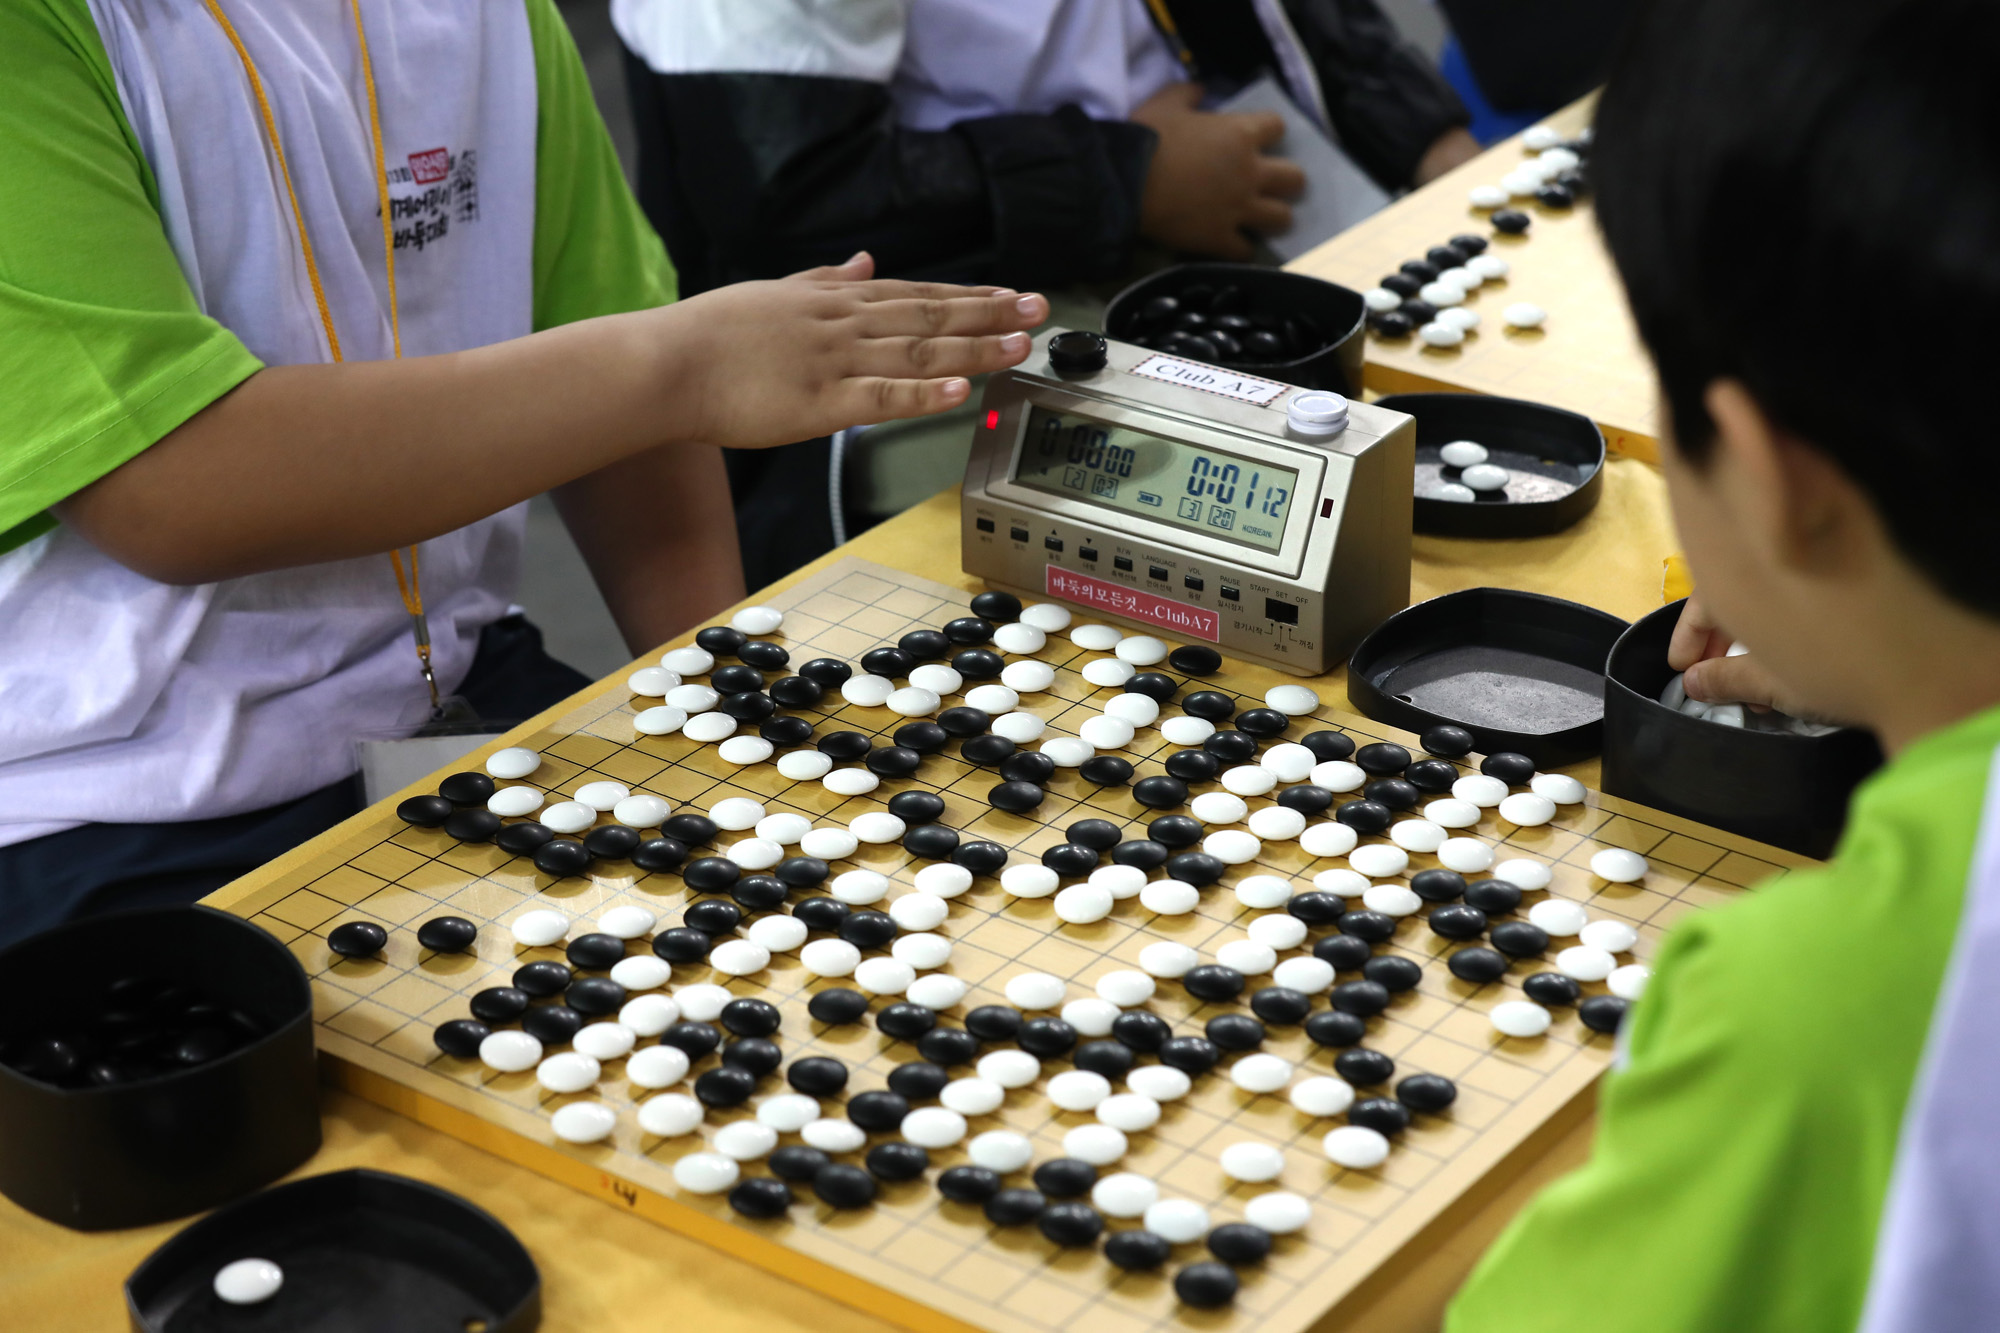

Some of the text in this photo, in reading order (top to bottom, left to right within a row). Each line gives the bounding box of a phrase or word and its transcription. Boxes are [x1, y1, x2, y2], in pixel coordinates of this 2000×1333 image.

[1156, 364, 1265, 395] Club A7
[1213, 508, 1232, 527] 20
[1141, 553, 1177, 569] LANGUAGE
[1188, 566, 1202, 576] VOL
[1220, 575, 1241, 586] PAUSE
[1250, 583, 1309, 605] START SET OFF
[1217, 600, 1244, 613] 일시정지
[1233, 620, 1263, 635] 경기시작
[1299, 639, 1314, 650] 꺼짐
